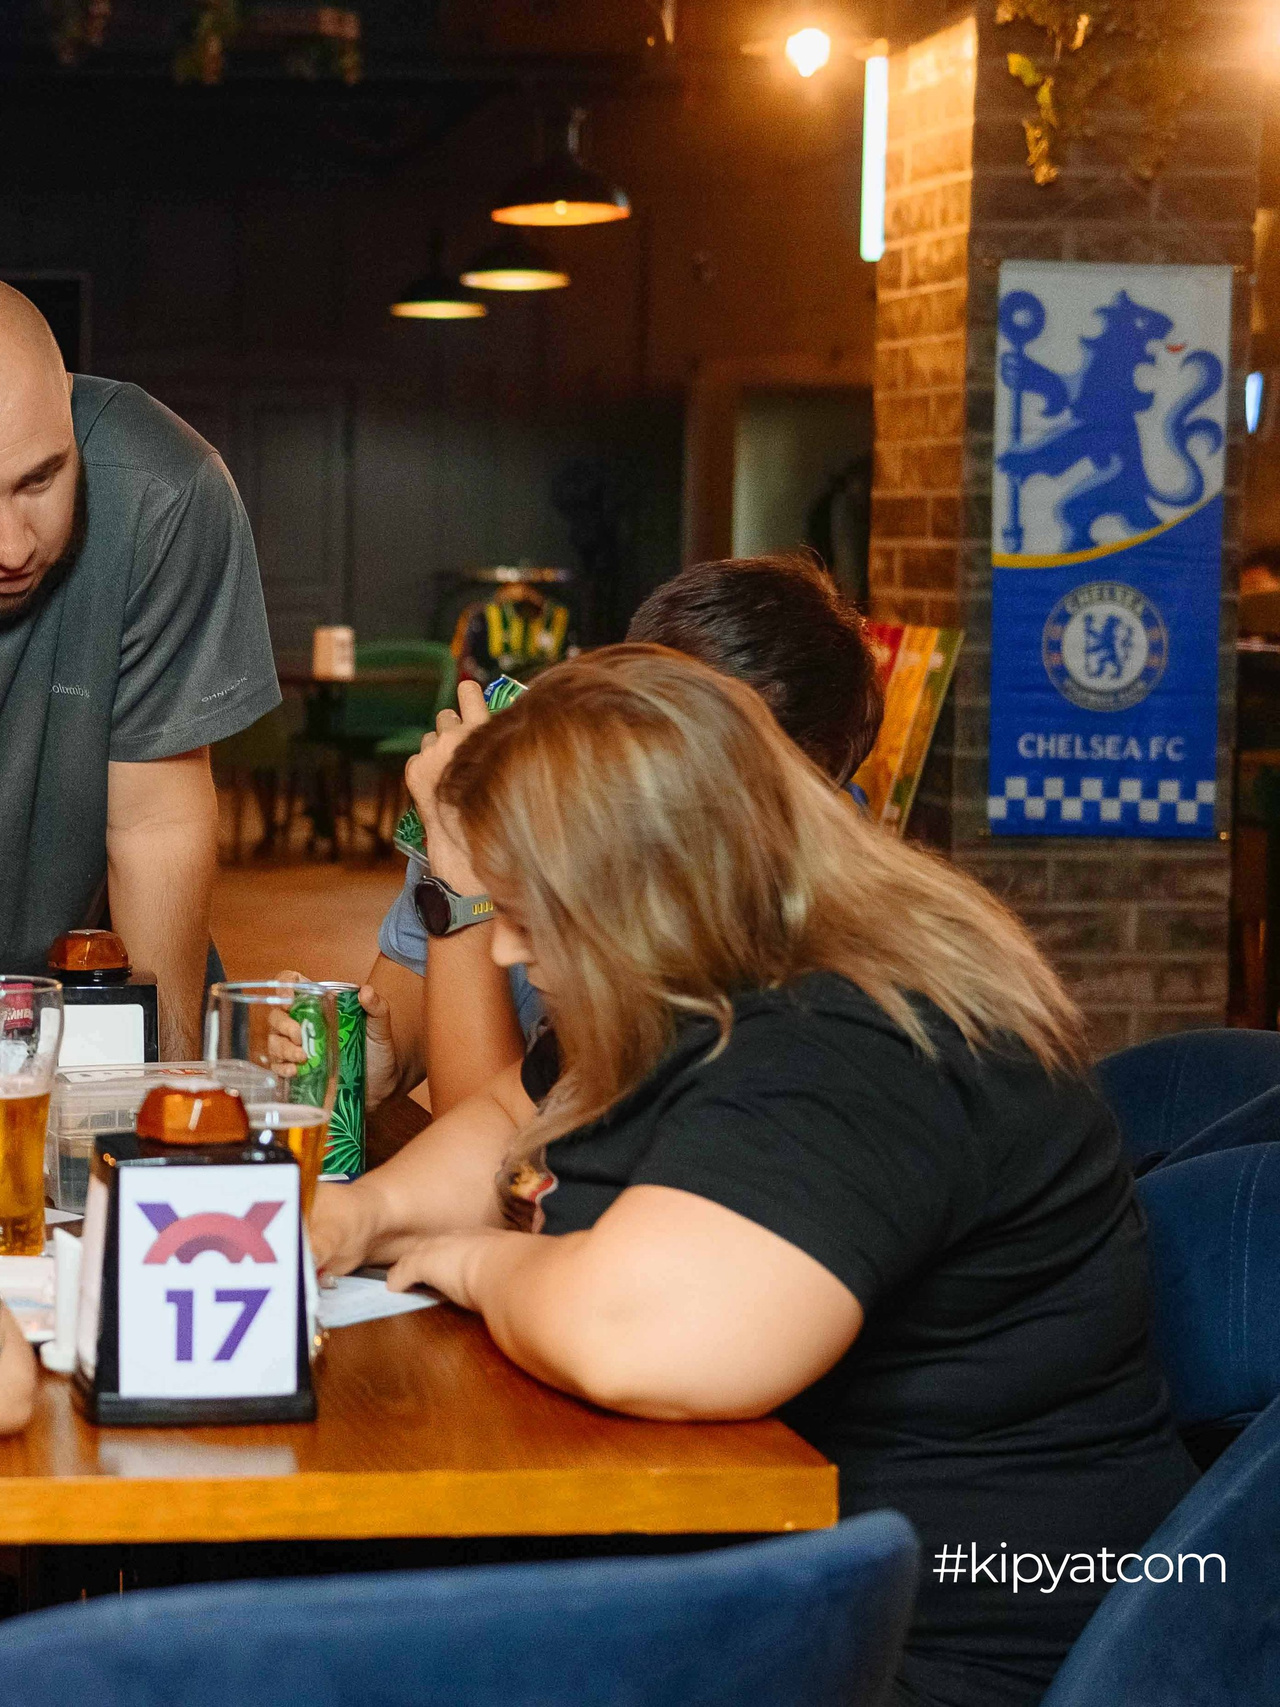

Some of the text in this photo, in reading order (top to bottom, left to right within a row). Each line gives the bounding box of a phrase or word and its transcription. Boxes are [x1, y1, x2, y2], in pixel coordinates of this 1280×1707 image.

[1017, 732, 1186, 762] CHELSEA FC
[165, 1287, 272, 1362] 17
